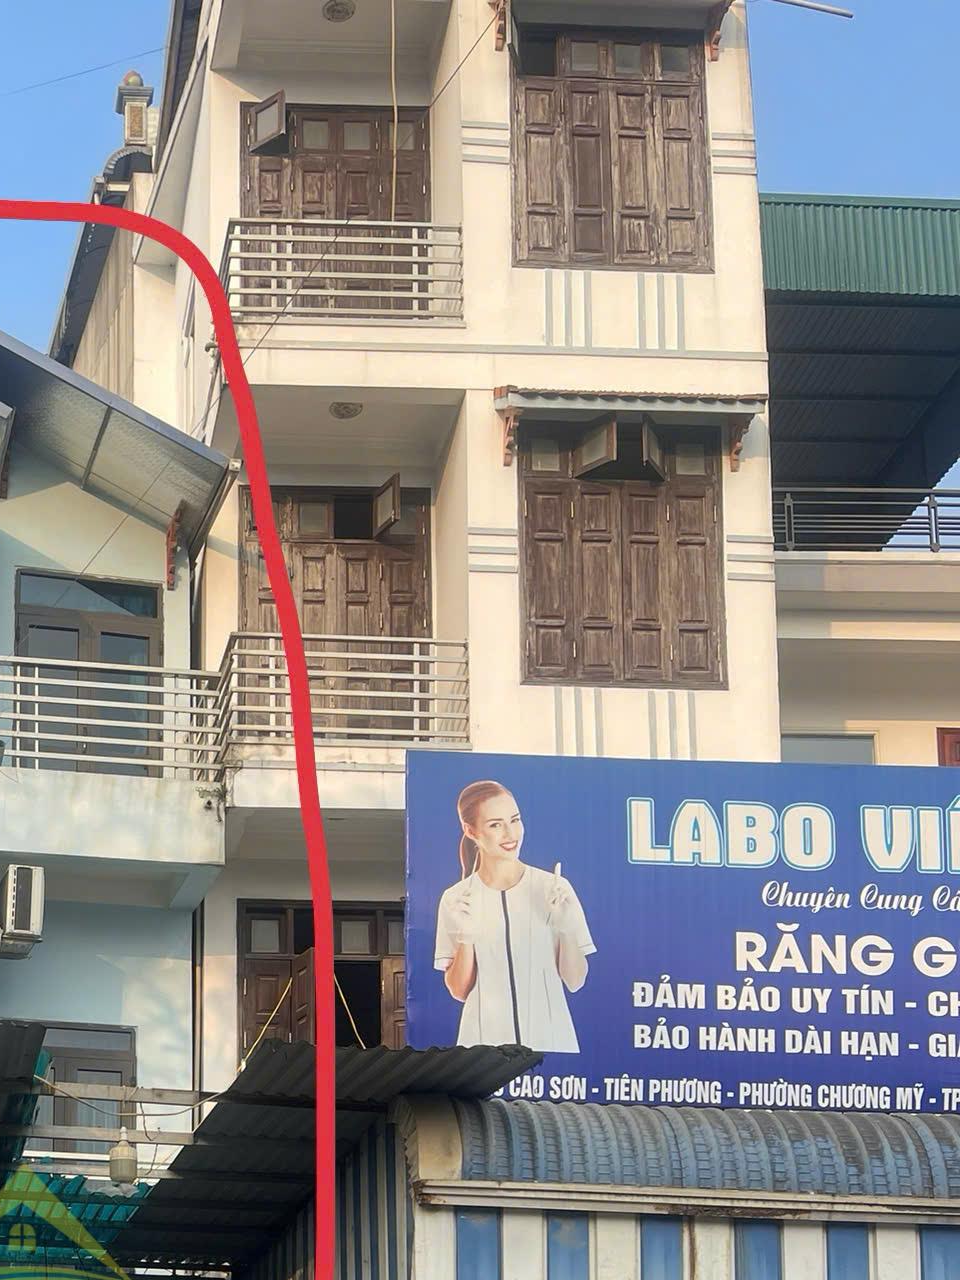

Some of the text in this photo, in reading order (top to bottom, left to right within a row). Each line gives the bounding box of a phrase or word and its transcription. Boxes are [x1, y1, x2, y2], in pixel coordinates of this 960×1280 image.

[627, 795, 960, 874] LABO VI
[761, 880, 852, 914] Chuyên
[859, 883, 925, 917] Cung
[735, 922, 895, 976] RĂNG
[632, 974, 706, 1009] ĐẢM
[716, 977, 781, 1012] BẢO
[791, 986, 833, 1014] UY
[842, 984, 894, 1016] TÍN
[633, 1017, 690, 1050] BẢO
[699, 1022, 776, 1053] HÀNH
[784, 1025, 832, 1055] DÀI
[840, 1030, 900, 1062] HẠN
[508, 1075, 545, 1099] CAO
[549, 1074, 588, 1100] SƠN
[603, 1073, 644, 1101] TIÊN
[648, 1078, 722, 1105] PHƯƠNG
[739, 1077, 813, 1107] PHƯỜNG
[817, 1082, 891, 1110] CHƯƠNG
[896, 1082, 925, 1111] MỸ
